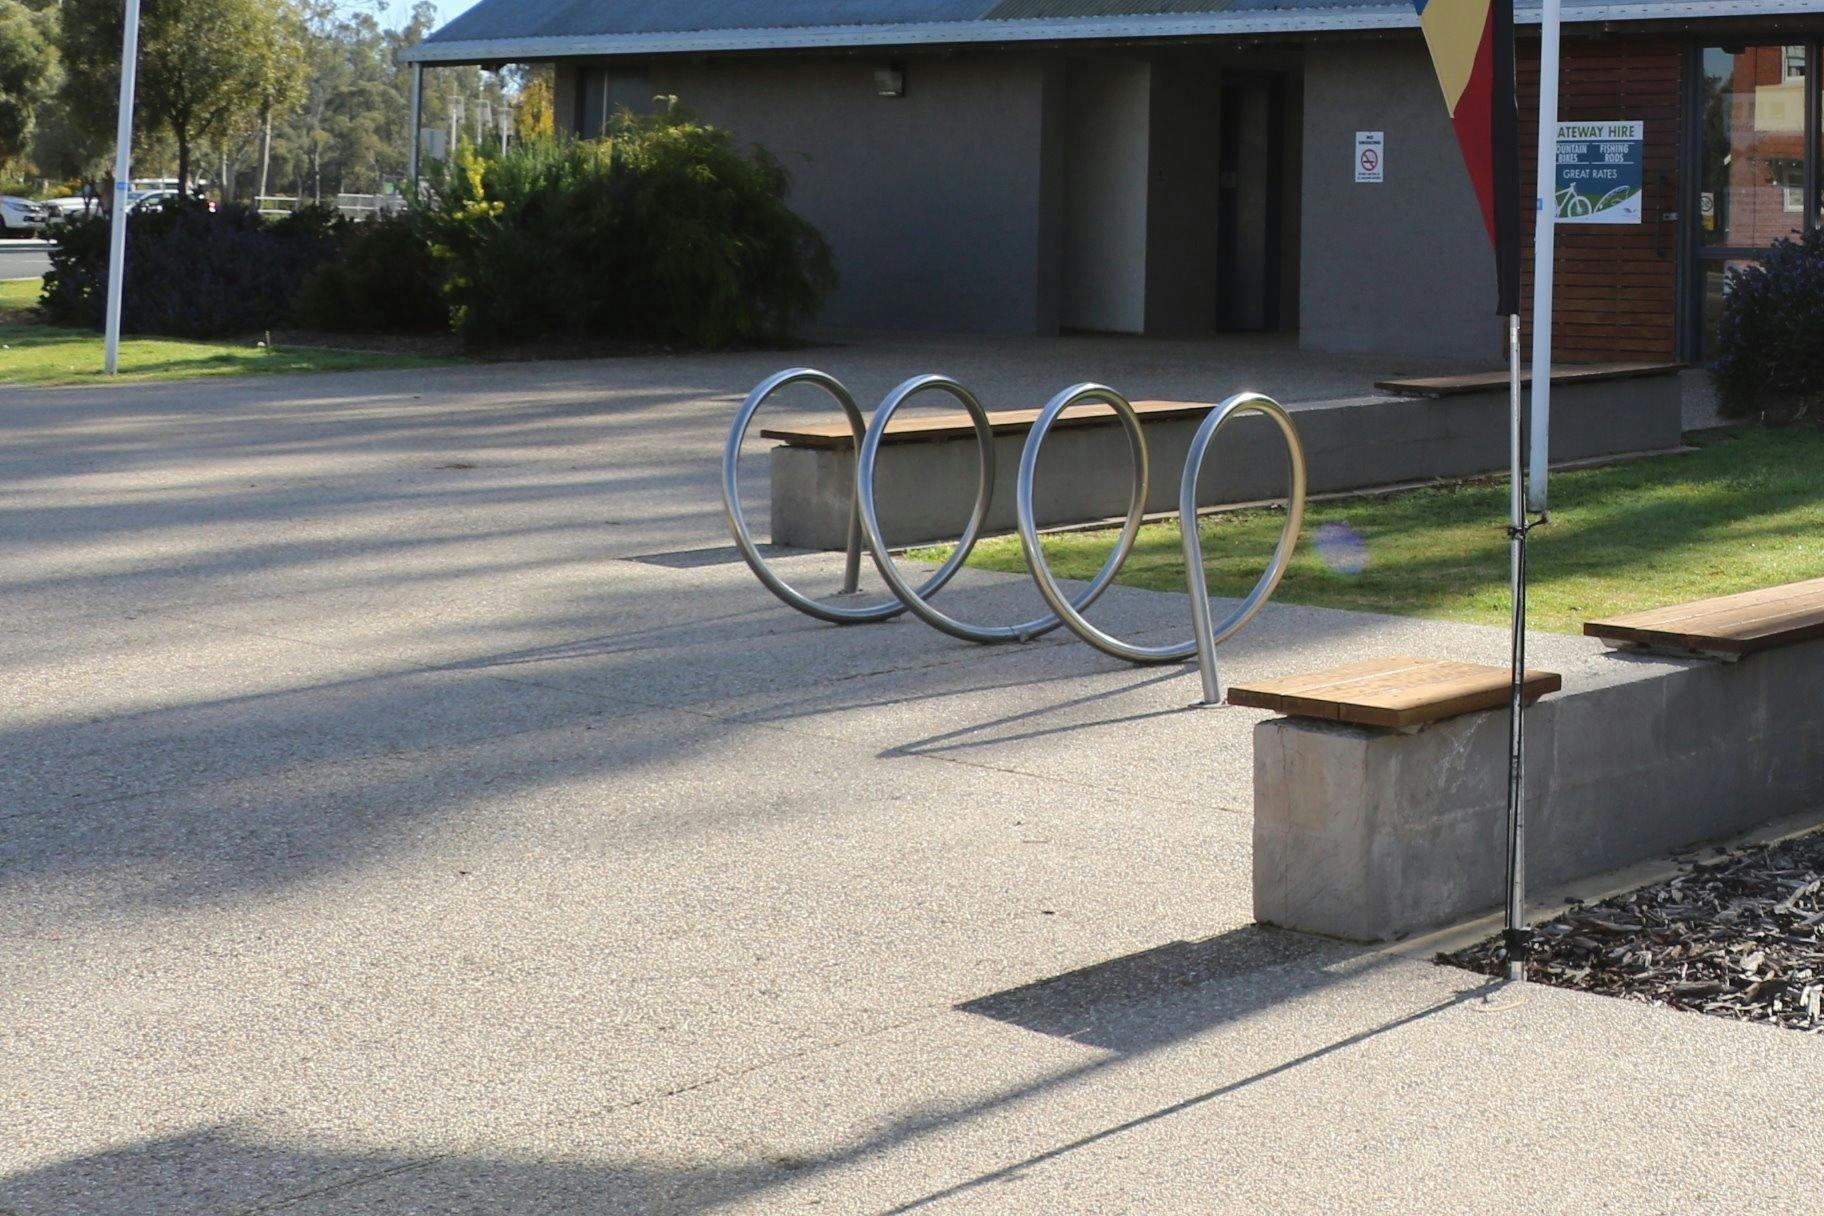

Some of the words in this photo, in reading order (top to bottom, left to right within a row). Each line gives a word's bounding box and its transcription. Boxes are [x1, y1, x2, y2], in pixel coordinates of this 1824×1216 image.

[1557, 126, 1604, 138] ATEWAY
[1608, 125, 1635, 138] HIRE
[1556, 144, 1588, 154] OUNTAIN
[1600, 144, 1629, 154] FISHING
[1558, 153, 1578, 163] BIKES
[1604, 153, 1625, 163] RODS
[1562, 169, 1590, 179] GREAT
[1592, 169, 1618, 179] RATES
